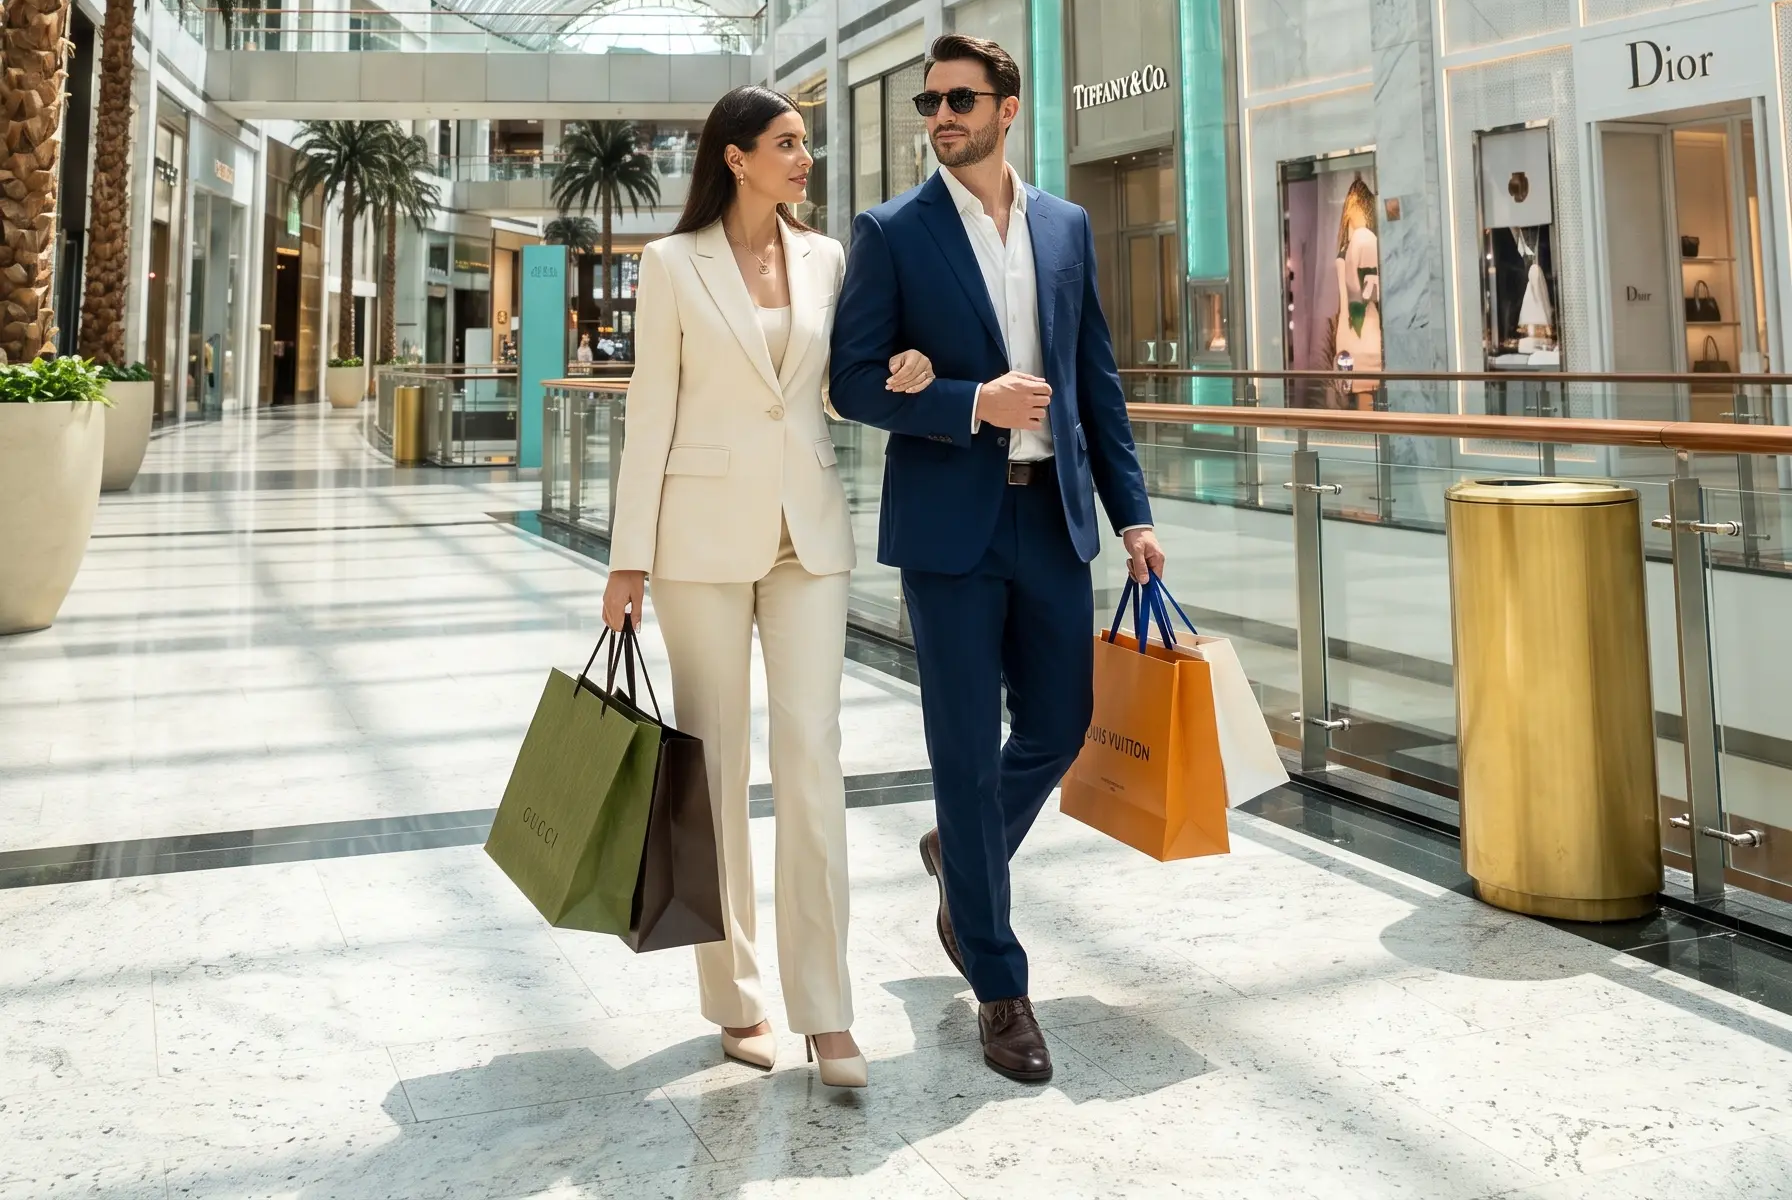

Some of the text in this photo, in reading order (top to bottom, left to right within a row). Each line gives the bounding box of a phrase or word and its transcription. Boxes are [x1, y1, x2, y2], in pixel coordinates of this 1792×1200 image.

[1626, 40, 1713, 89] Dior
[1086, 724, 1150, 762] OUIS VUITTON
[523, 806, 558, 849] GUCCI
